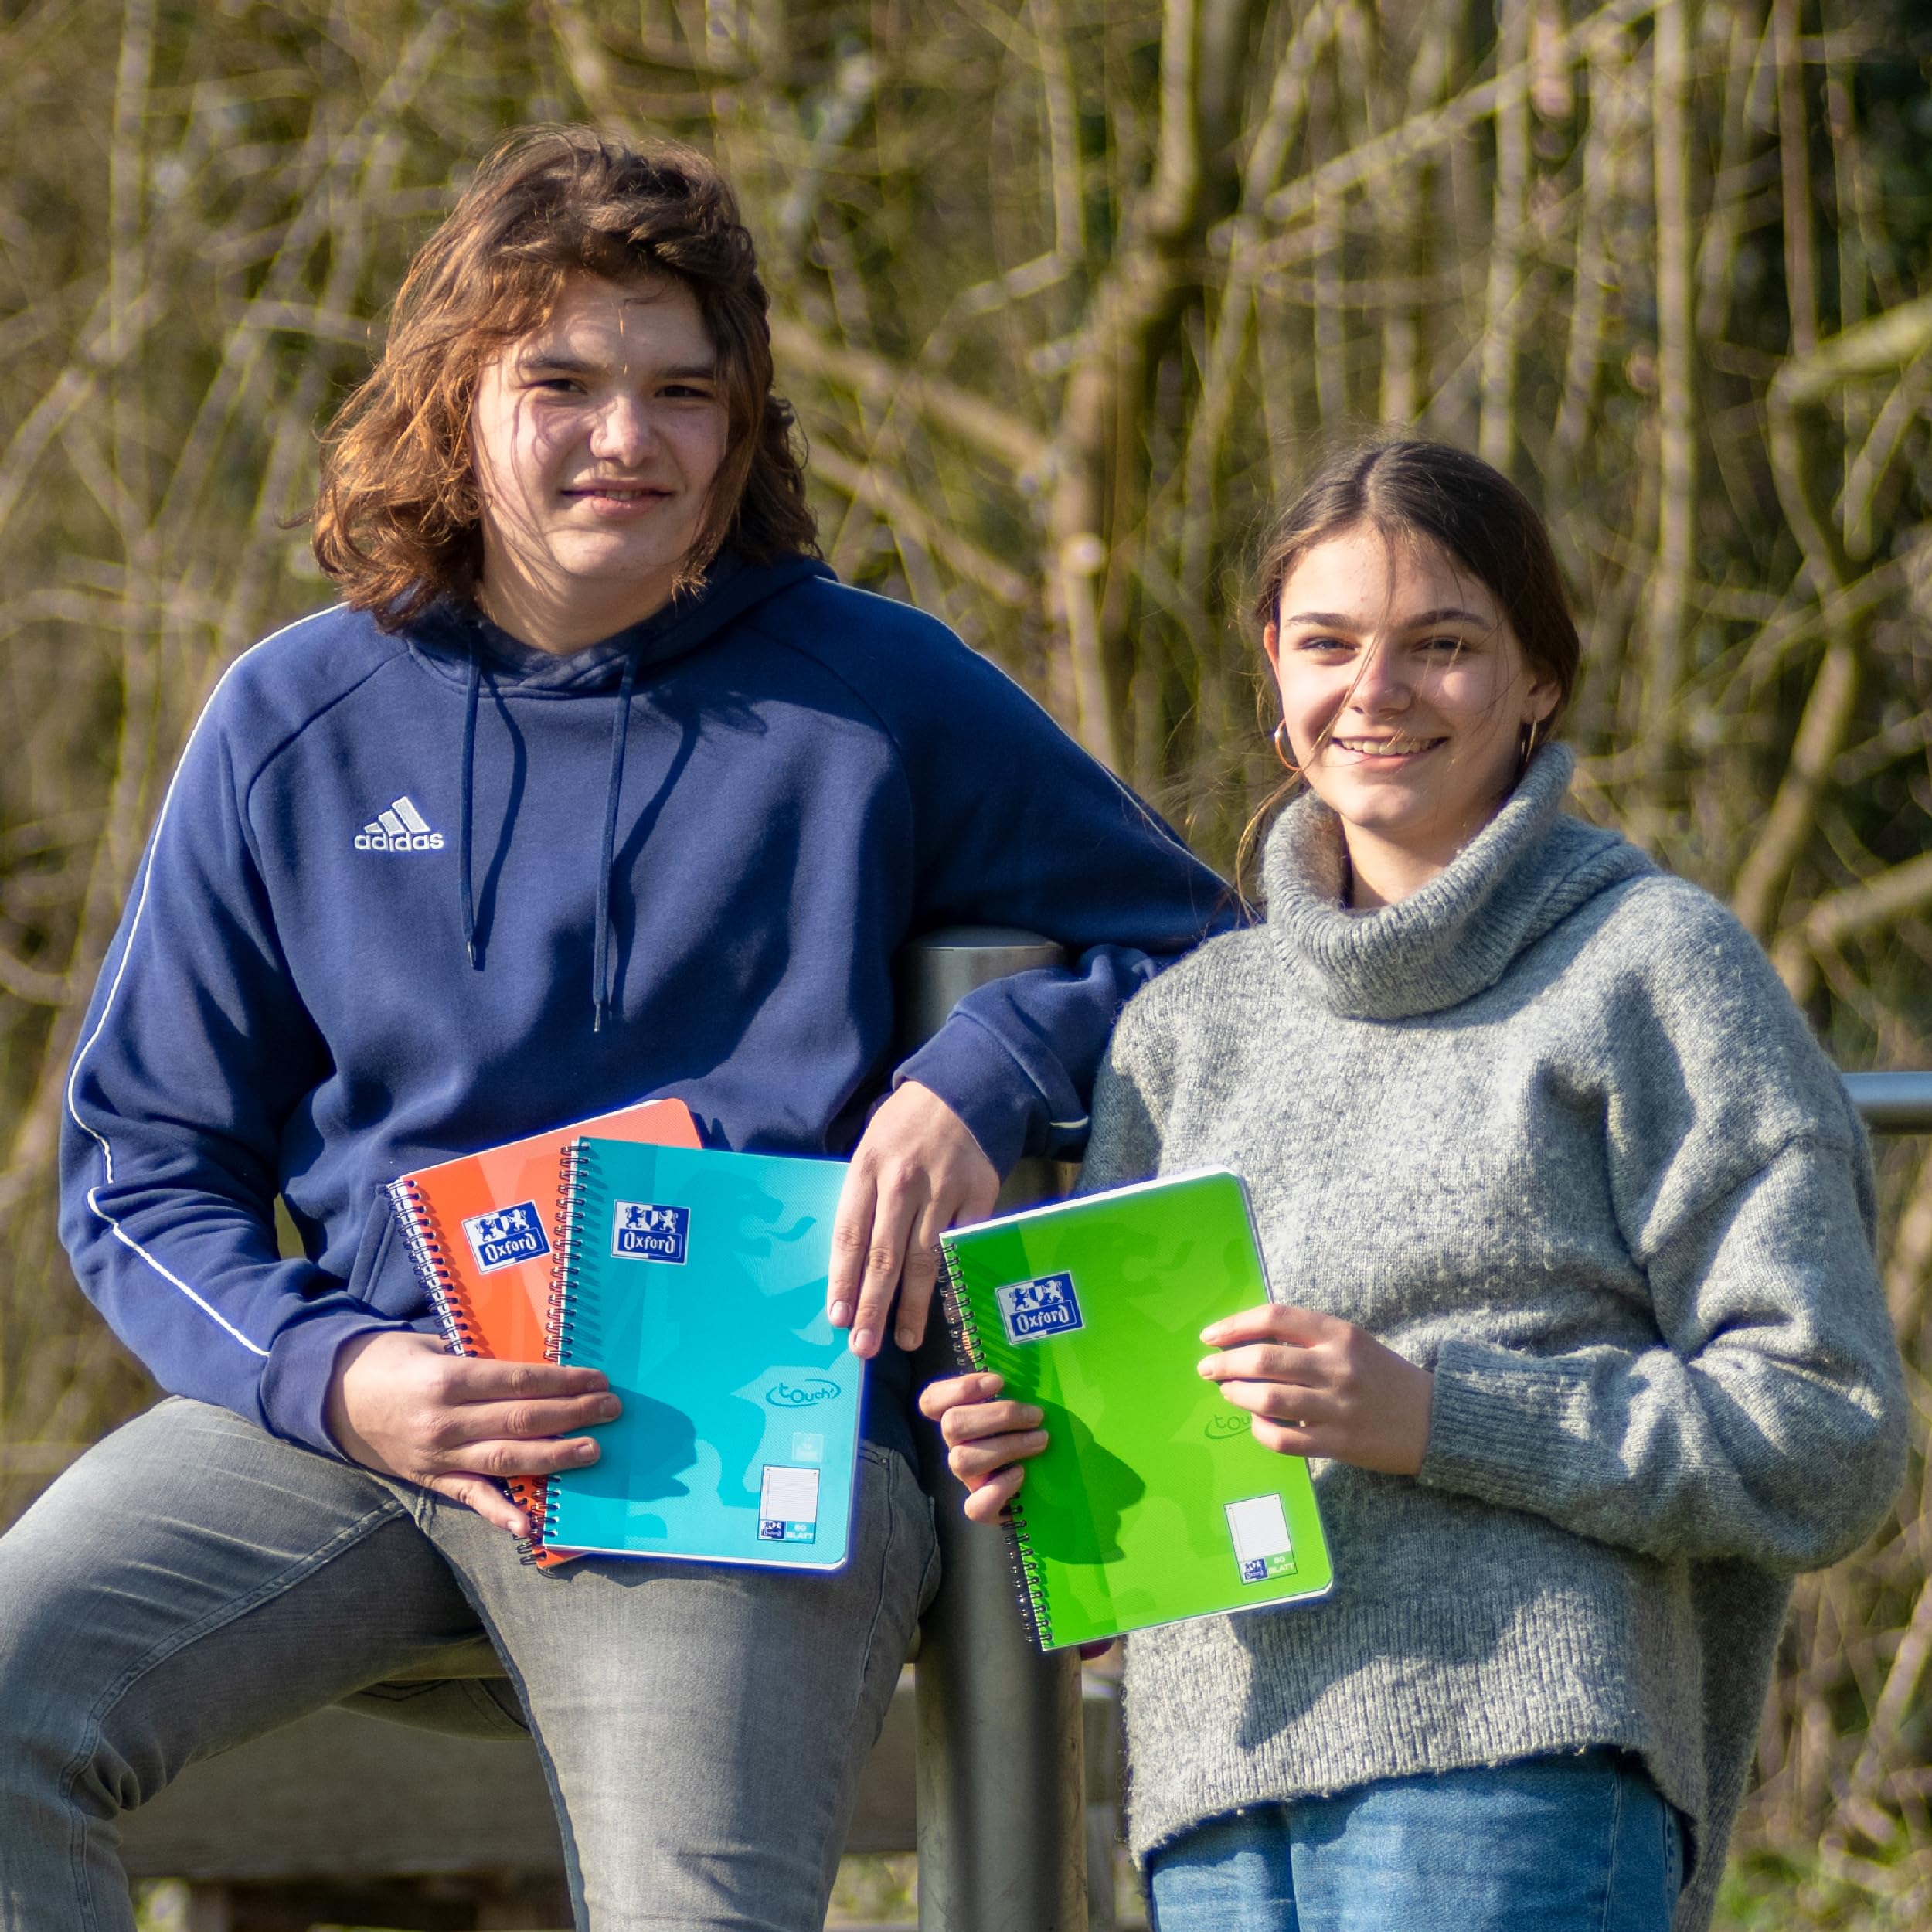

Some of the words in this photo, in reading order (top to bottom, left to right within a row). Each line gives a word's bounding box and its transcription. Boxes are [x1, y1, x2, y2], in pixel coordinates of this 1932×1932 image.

[354, 832, 444, 852] adidas
[485, 1232, 537, 1263] Oxford
[624, 1230, 675, 1254] Oxford
[1016, 1304, 1070, 1334] Oxford
[1213, 1414, 1251, 1430] tou
